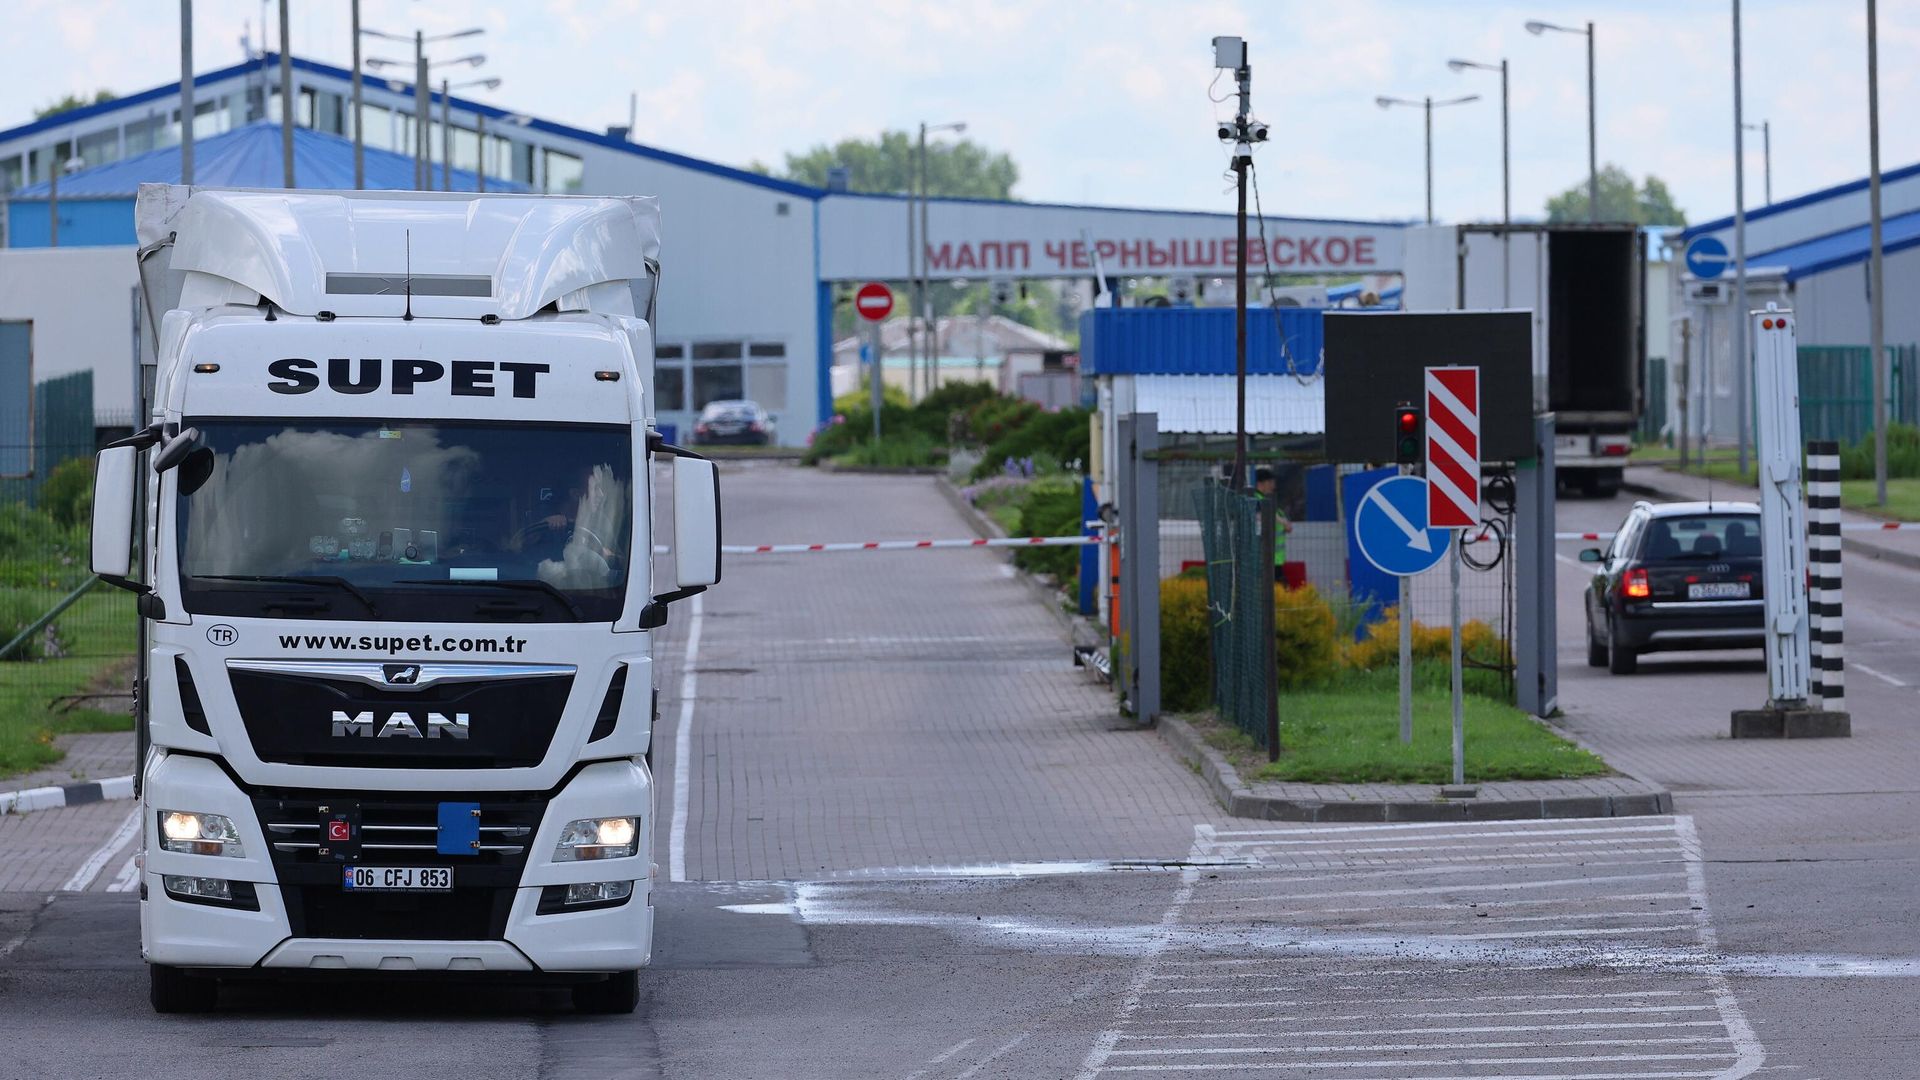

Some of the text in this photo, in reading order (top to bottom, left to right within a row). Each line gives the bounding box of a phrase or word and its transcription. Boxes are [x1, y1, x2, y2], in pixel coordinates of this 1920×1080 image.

[926, 236, 1376, 270] МАПП ЧЕРНЫШЕВСКОЕ
[267, 358, 550, 399] SUPET
[212, 628, 233, 642] TR
[279, 633, 527, 655] www.supet.com.tr
[331, 711, 470, 740] MAN
[355, 868, 449, 888] 06 CFJ 853
